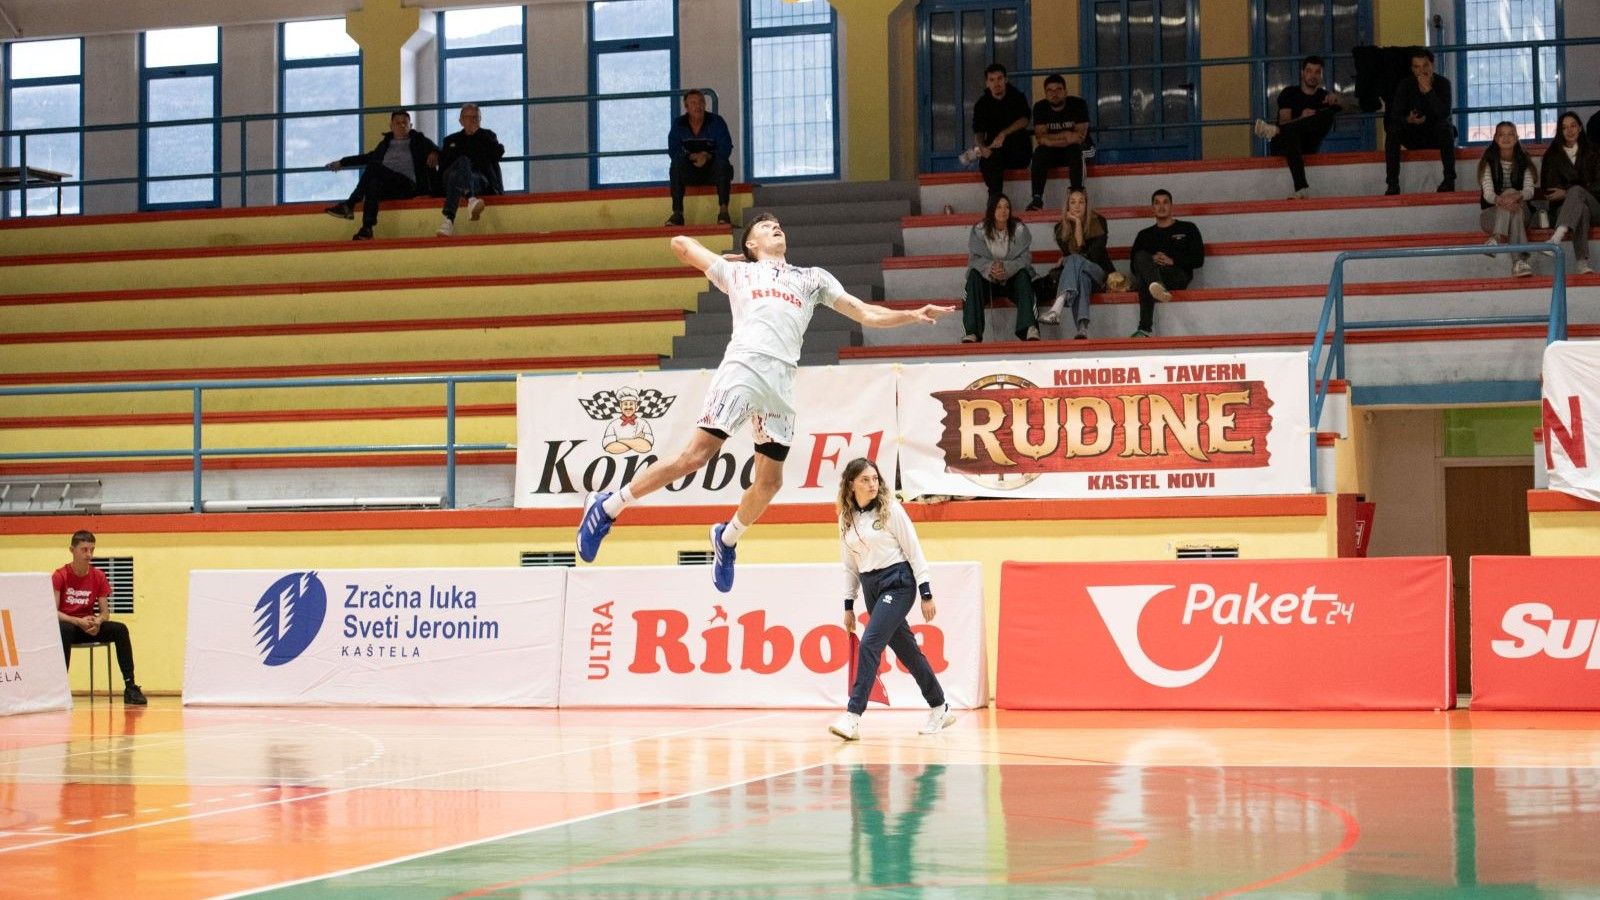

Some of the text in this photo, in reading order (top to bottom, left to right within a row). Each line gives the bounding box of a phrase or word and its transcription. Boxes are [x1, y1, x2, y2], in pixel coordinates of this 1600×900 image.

[752, 288, 802, 308] Ribola
[1053, 366, 1142, 386] KONOBA
[1164, 363, 1247, 383] TAVERN
[957, 388, 1256, 467] RUDINE
[1087, 472, 1216, 491] KASTEL NOVI
[66, 587, 92, 597] Super
[66, 596, 90, 605] Sport
[344, 584, 477, 609] Zračna luka
[1182, 582, 1339, 625] Paket
[343, 614, 499, 640] Sveti Jeronim
[341, 644, 420, 657] KAŠTELA
[588, 601, 615, 680] ULTRA
